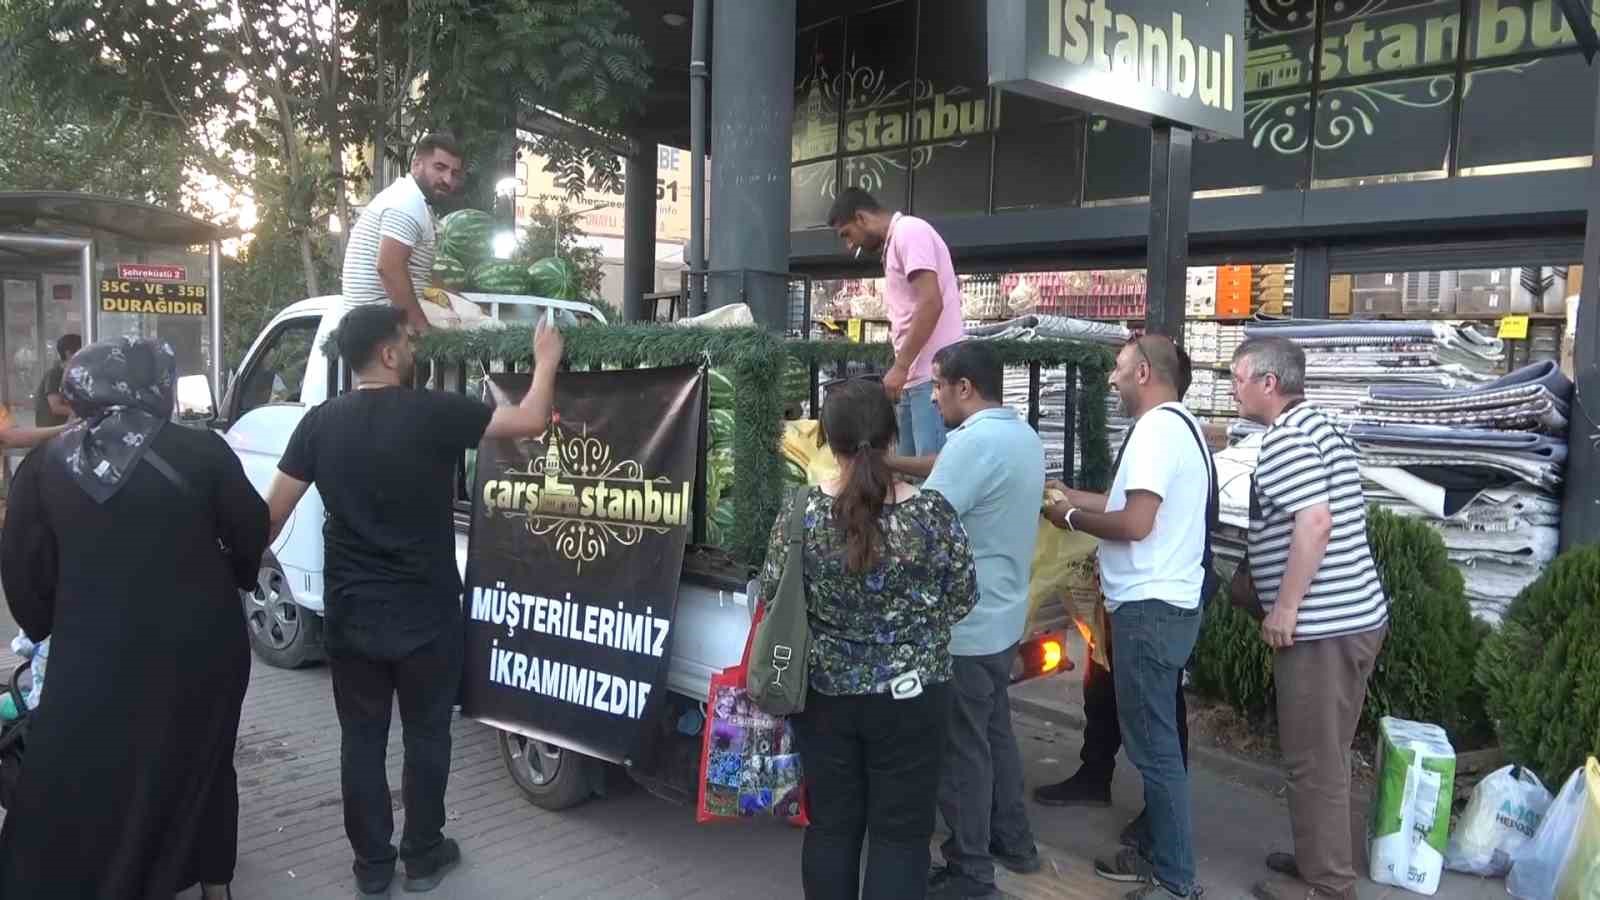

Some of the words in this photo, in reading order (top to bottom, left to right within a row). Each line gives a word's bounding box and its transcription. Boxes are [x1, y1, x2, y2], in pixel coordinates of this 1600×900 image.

[101, 280, 130, 294] 35C
[144, 283, 164, 295] VE
[177, 285, 206, 298] 35B
[103, 297, 203, 315] DURAĞIDIR
[470, 580, 670, 658] MÜŞTERİLERİMİZ
